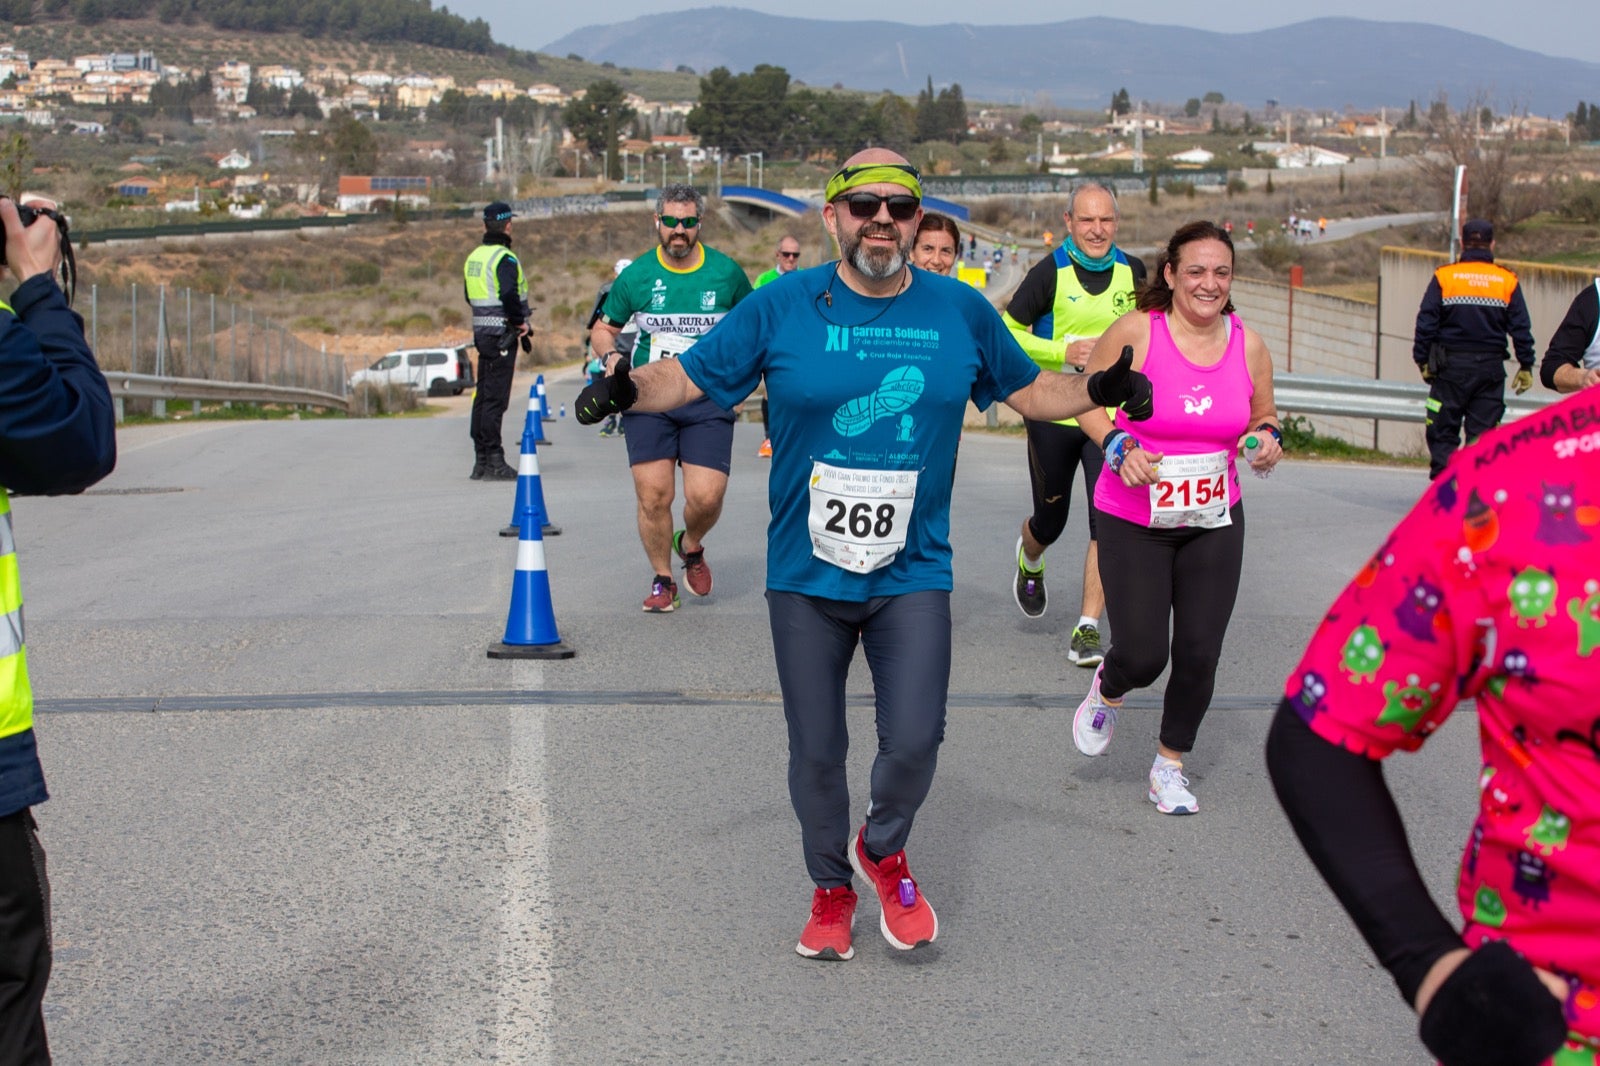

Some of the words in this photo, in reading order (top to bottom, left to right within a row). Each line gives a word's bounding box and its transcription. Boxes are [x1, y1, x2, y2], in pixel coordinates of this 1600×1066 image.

[1468, 280, 1489, 288] CIVIL
[646, 317, 674, 326] CAJA
[678, 316, 718, 326] RURAL
[825, 325, 849, 352] XI
[852, 326, 892, 338] Carrera
[894, 326, 939, 341] Solidaria
[873, 338, 910, 347] diciembre
[922, 341, 939, 349] 2022
[1156, 473, 1225, 508] 2154
[825, 498, 896, 538] 268
